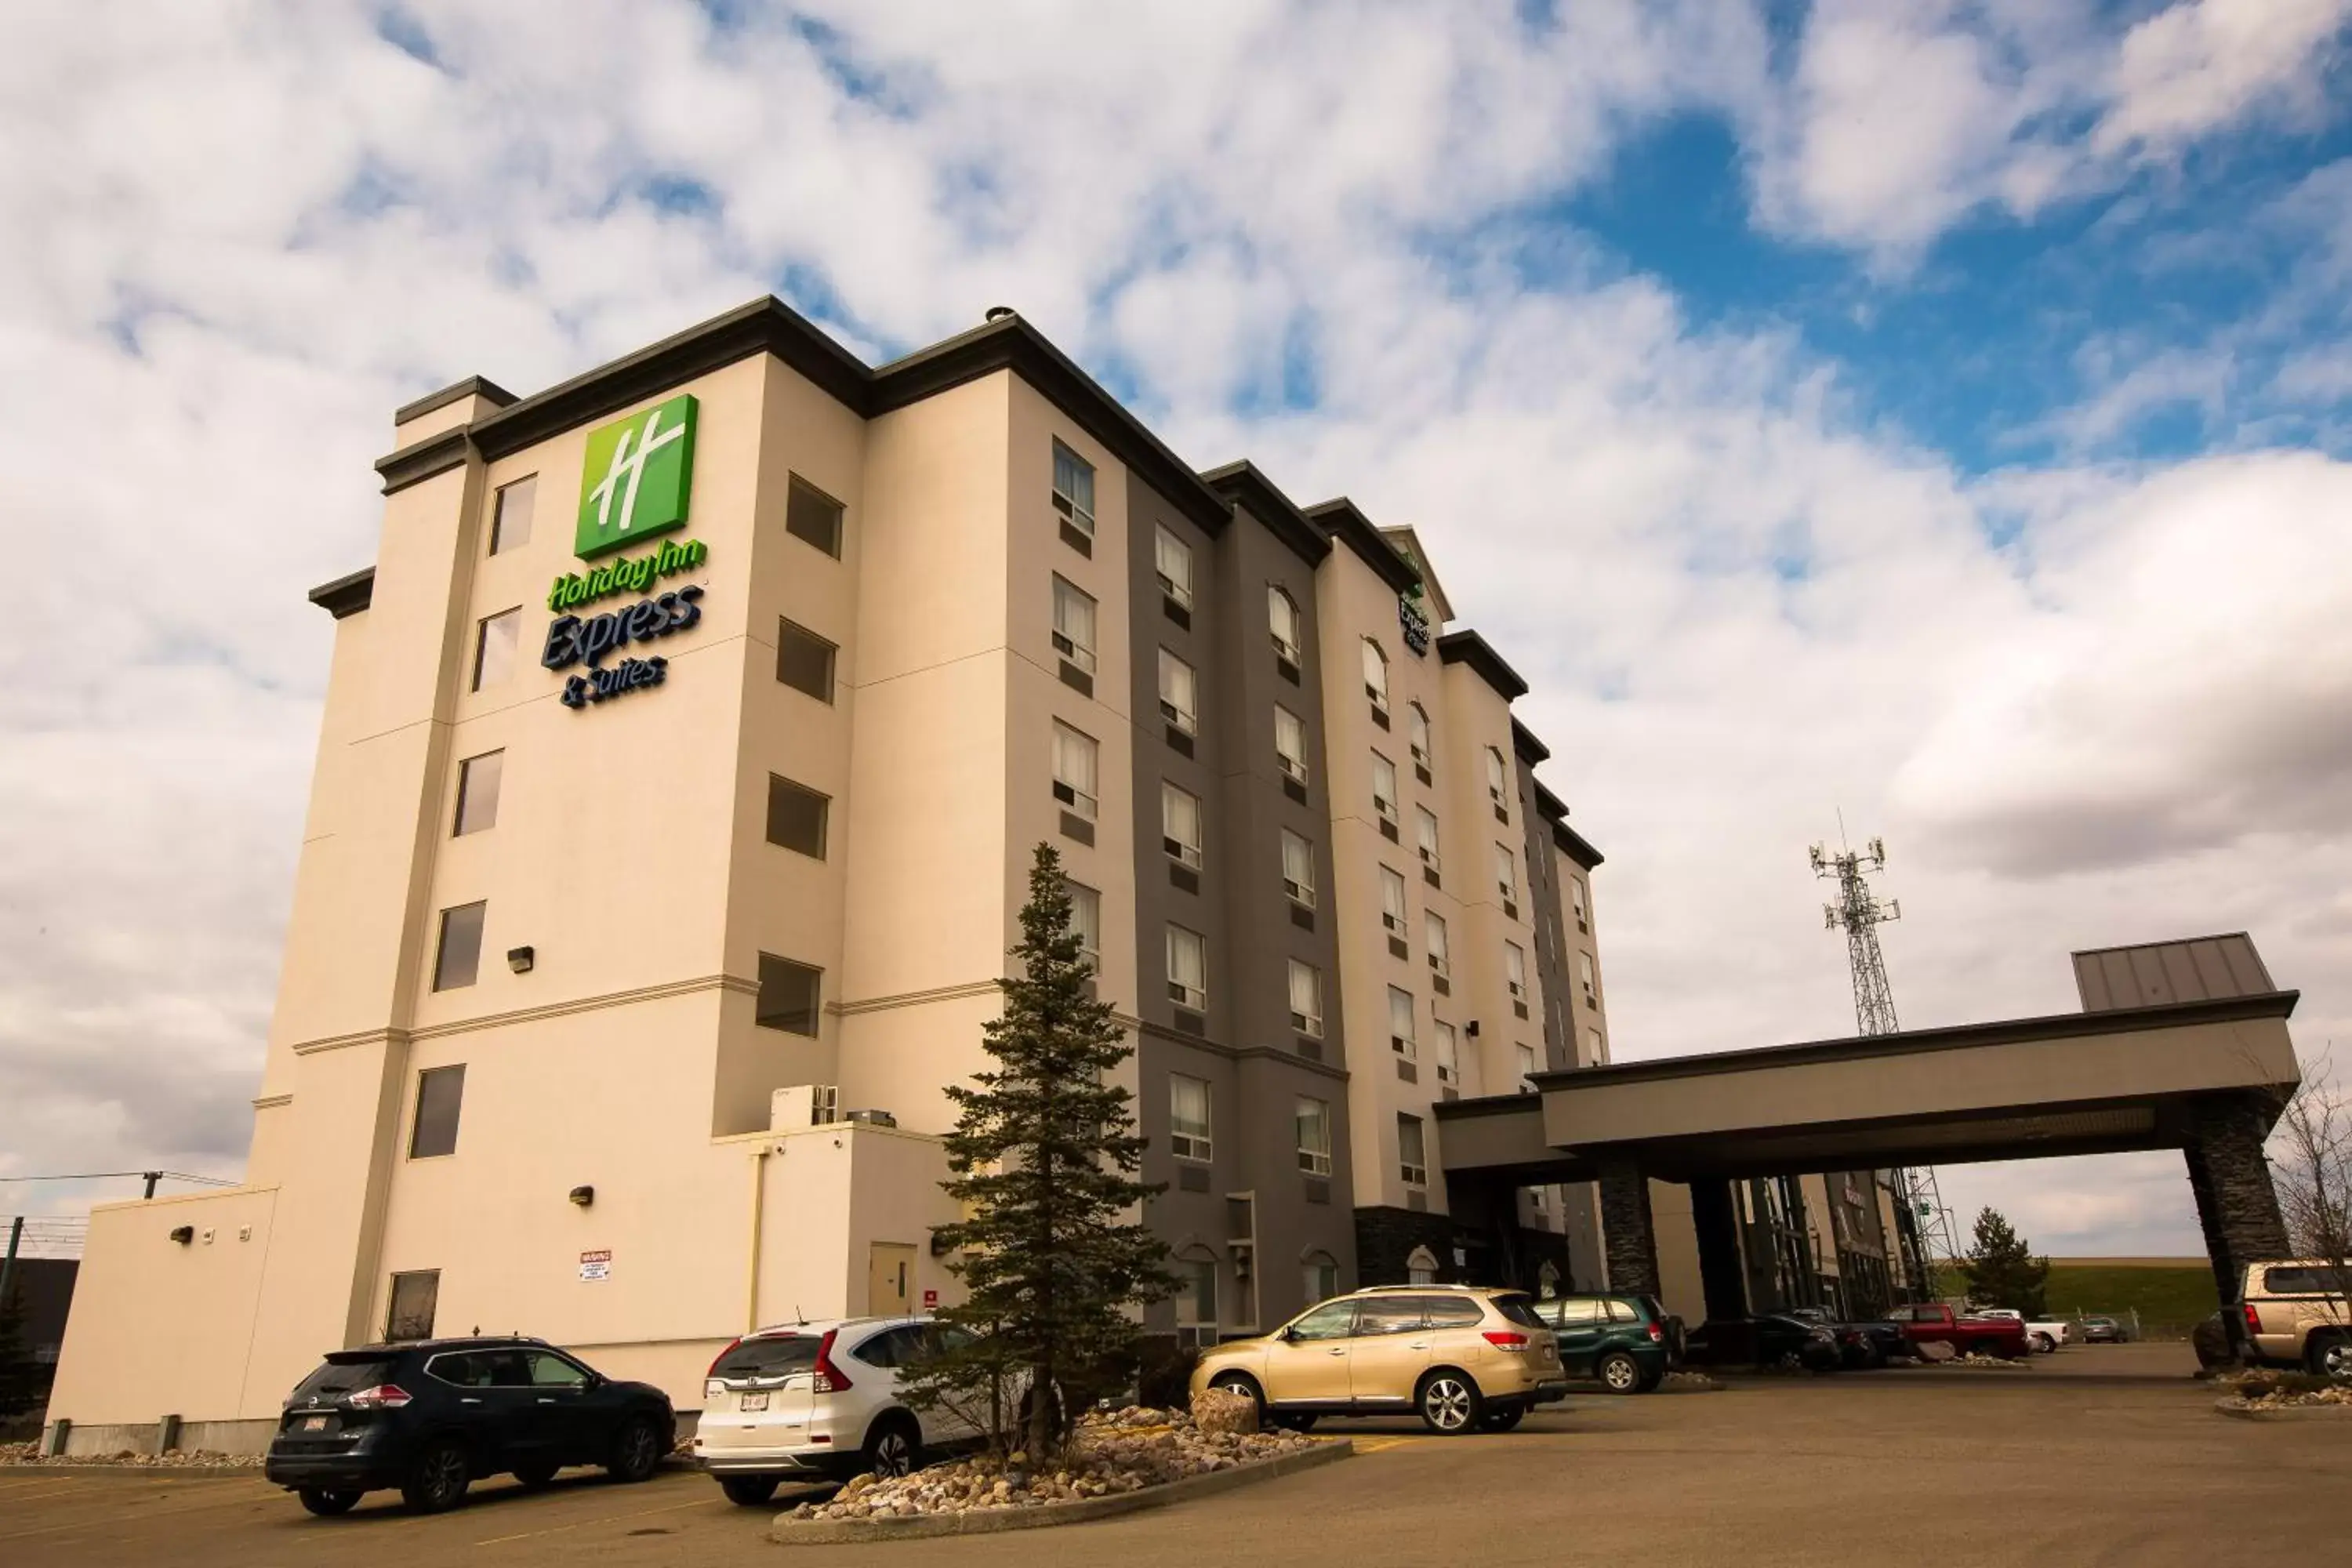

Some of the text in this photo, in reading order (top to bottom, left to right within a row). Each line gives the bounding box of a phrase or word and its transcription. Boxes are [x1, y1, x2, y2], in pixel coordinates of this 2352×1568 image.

[548, 539, 706, 613] Holiday Inn
[542, 585, 702, 670] Express
[561, 655, 668, 707] & Suites
